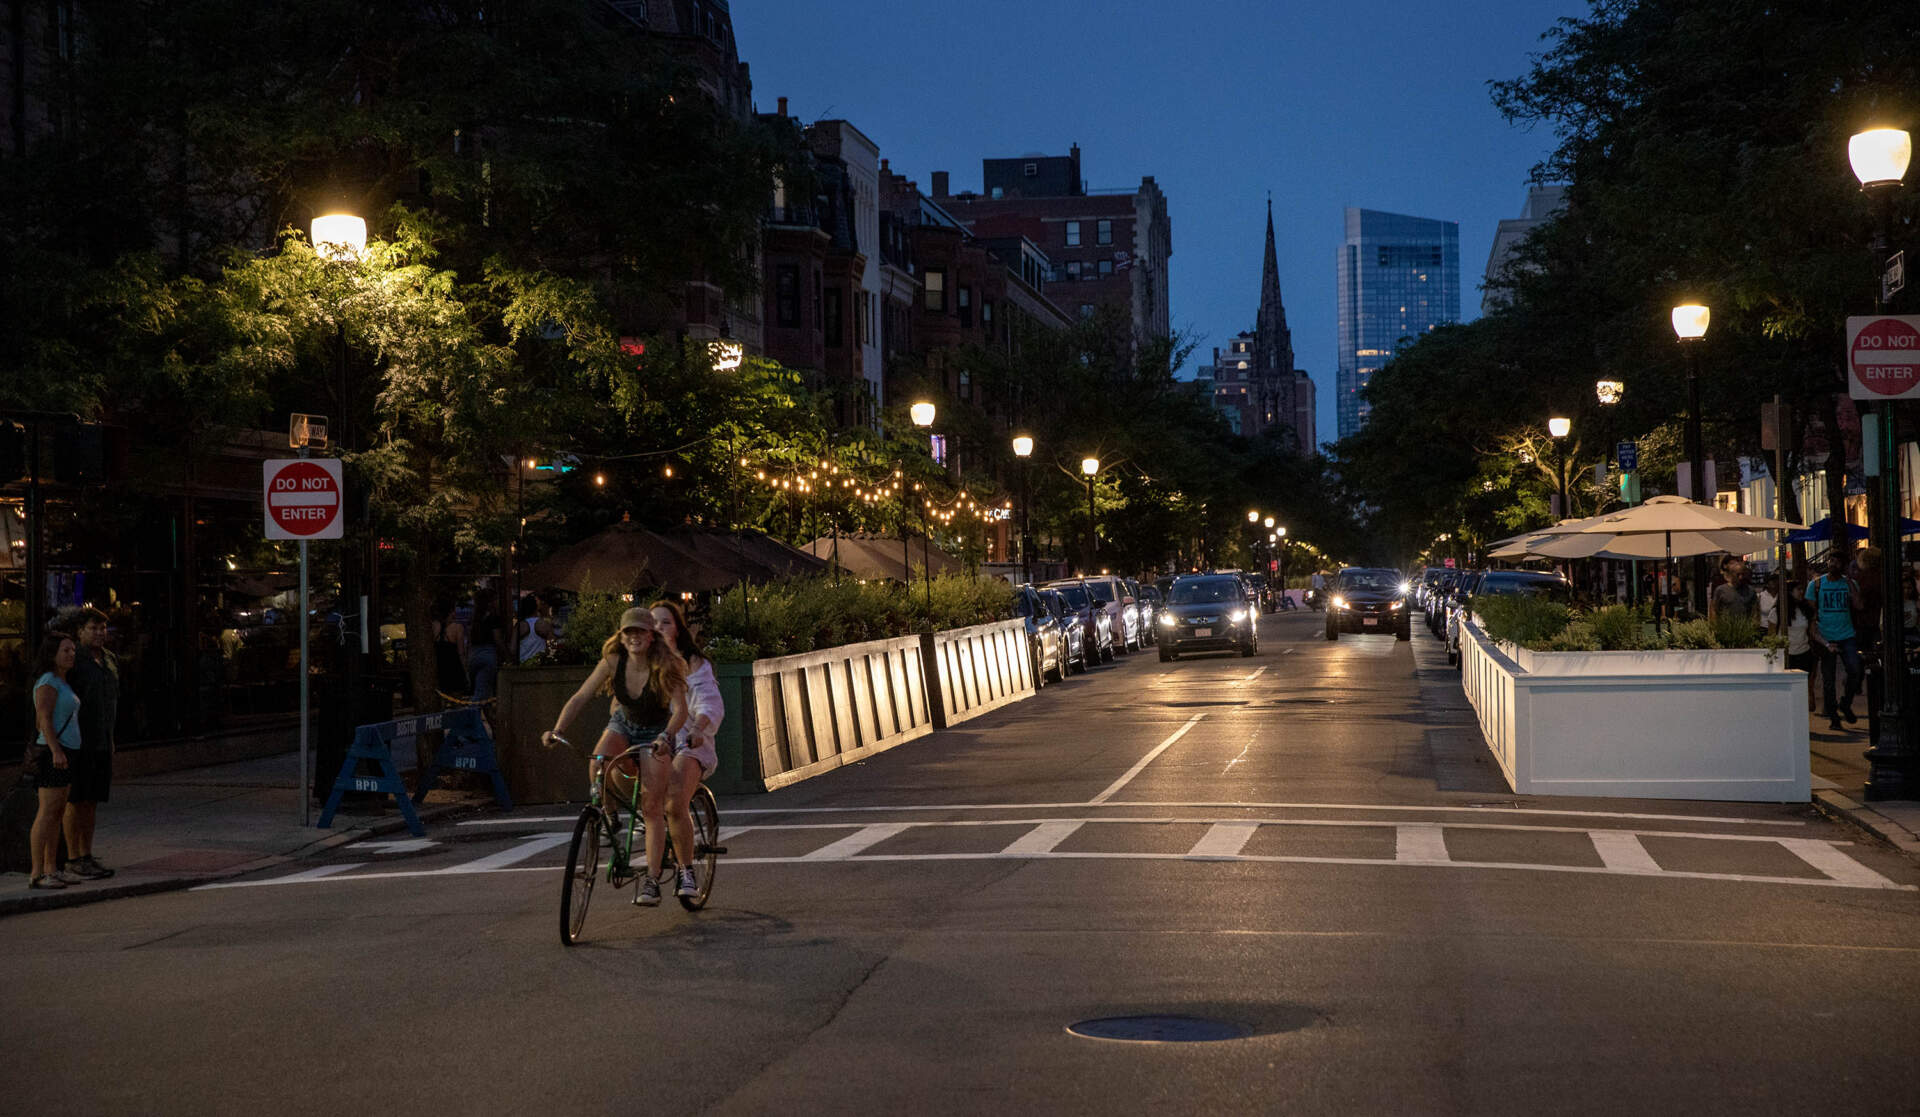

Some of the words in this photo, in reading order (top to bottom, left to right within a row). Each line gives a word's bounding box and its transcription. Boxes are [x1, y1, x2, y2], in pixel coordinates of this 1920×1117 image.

[1861, 335, 1882, 348] DO
[1888, 335, 1917, 348] NOT
[1866, 367, 1913, 379] ENTER
[276, 478, 296, 490] DO
[301, 477, 331, 490] NOT
[281, 508, 327, 520] ENTER
[396, 719, 417, 737] BOSTON
[425, 714, 443, 732] POLICE
[455, 757, 477, 769] BPD
[355, 780, 379, 792] BPD
